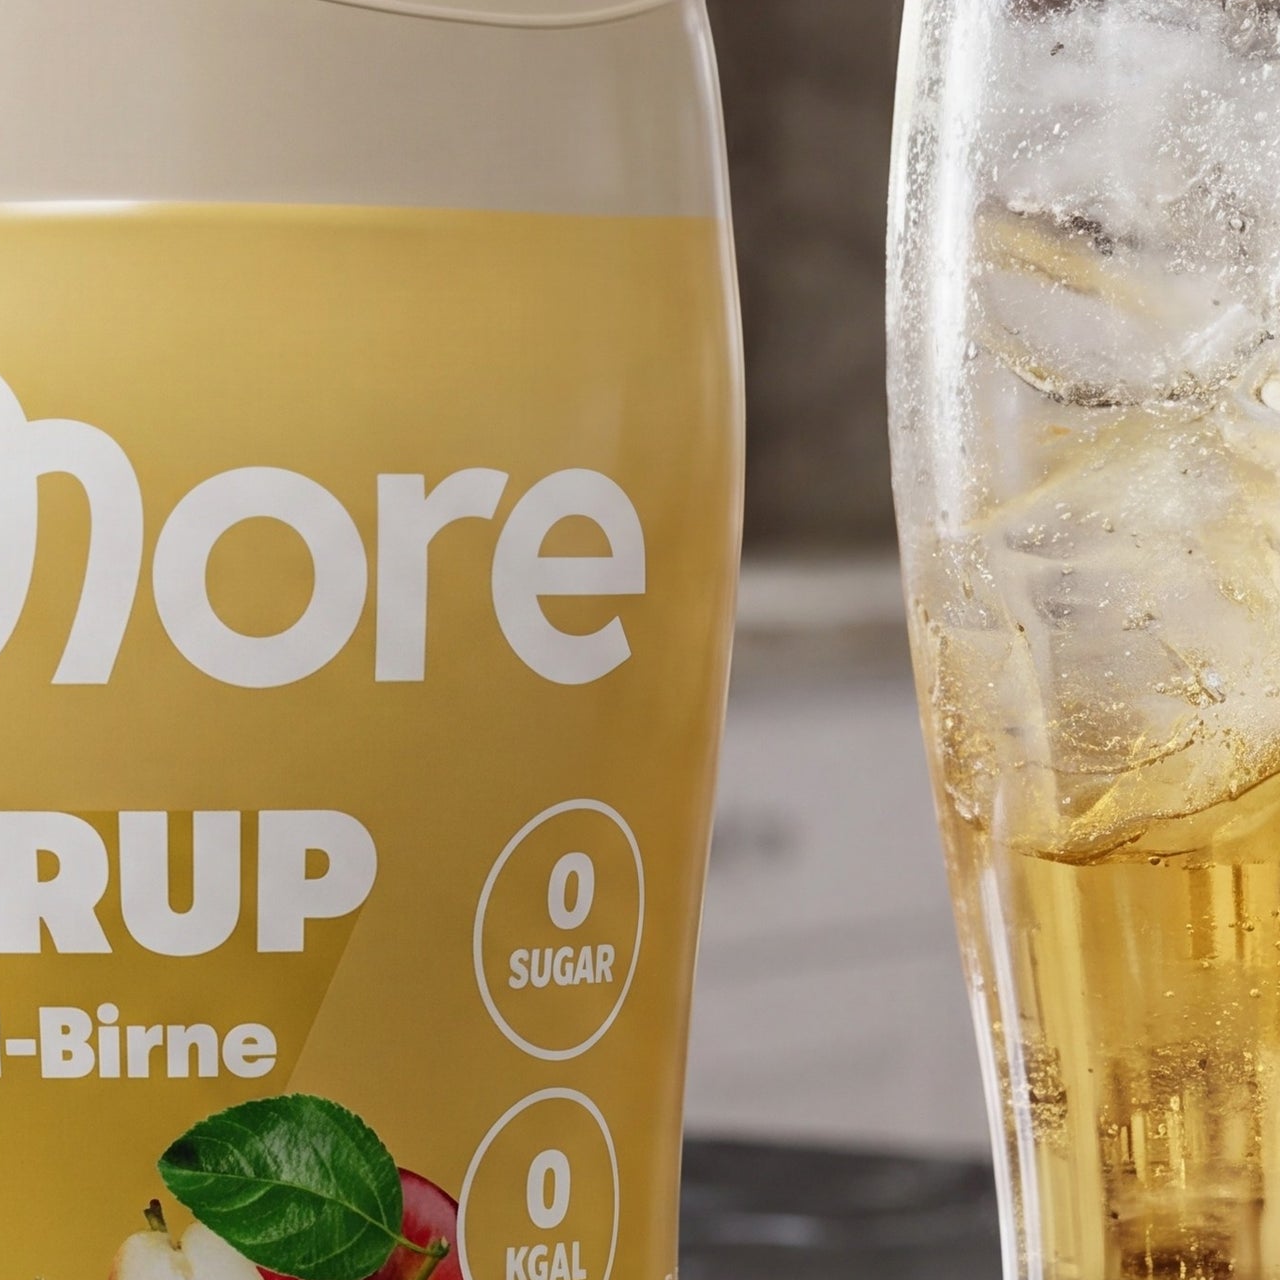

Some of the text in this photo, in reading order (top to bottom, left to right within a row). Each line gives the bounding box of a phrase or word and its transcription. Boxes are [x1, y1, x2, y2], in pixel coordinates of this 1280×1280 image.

[547, 851, 595, 930] 0
[508, 943, 616, 990] SUGAR
[526, 1148, 571, 1230] 0
